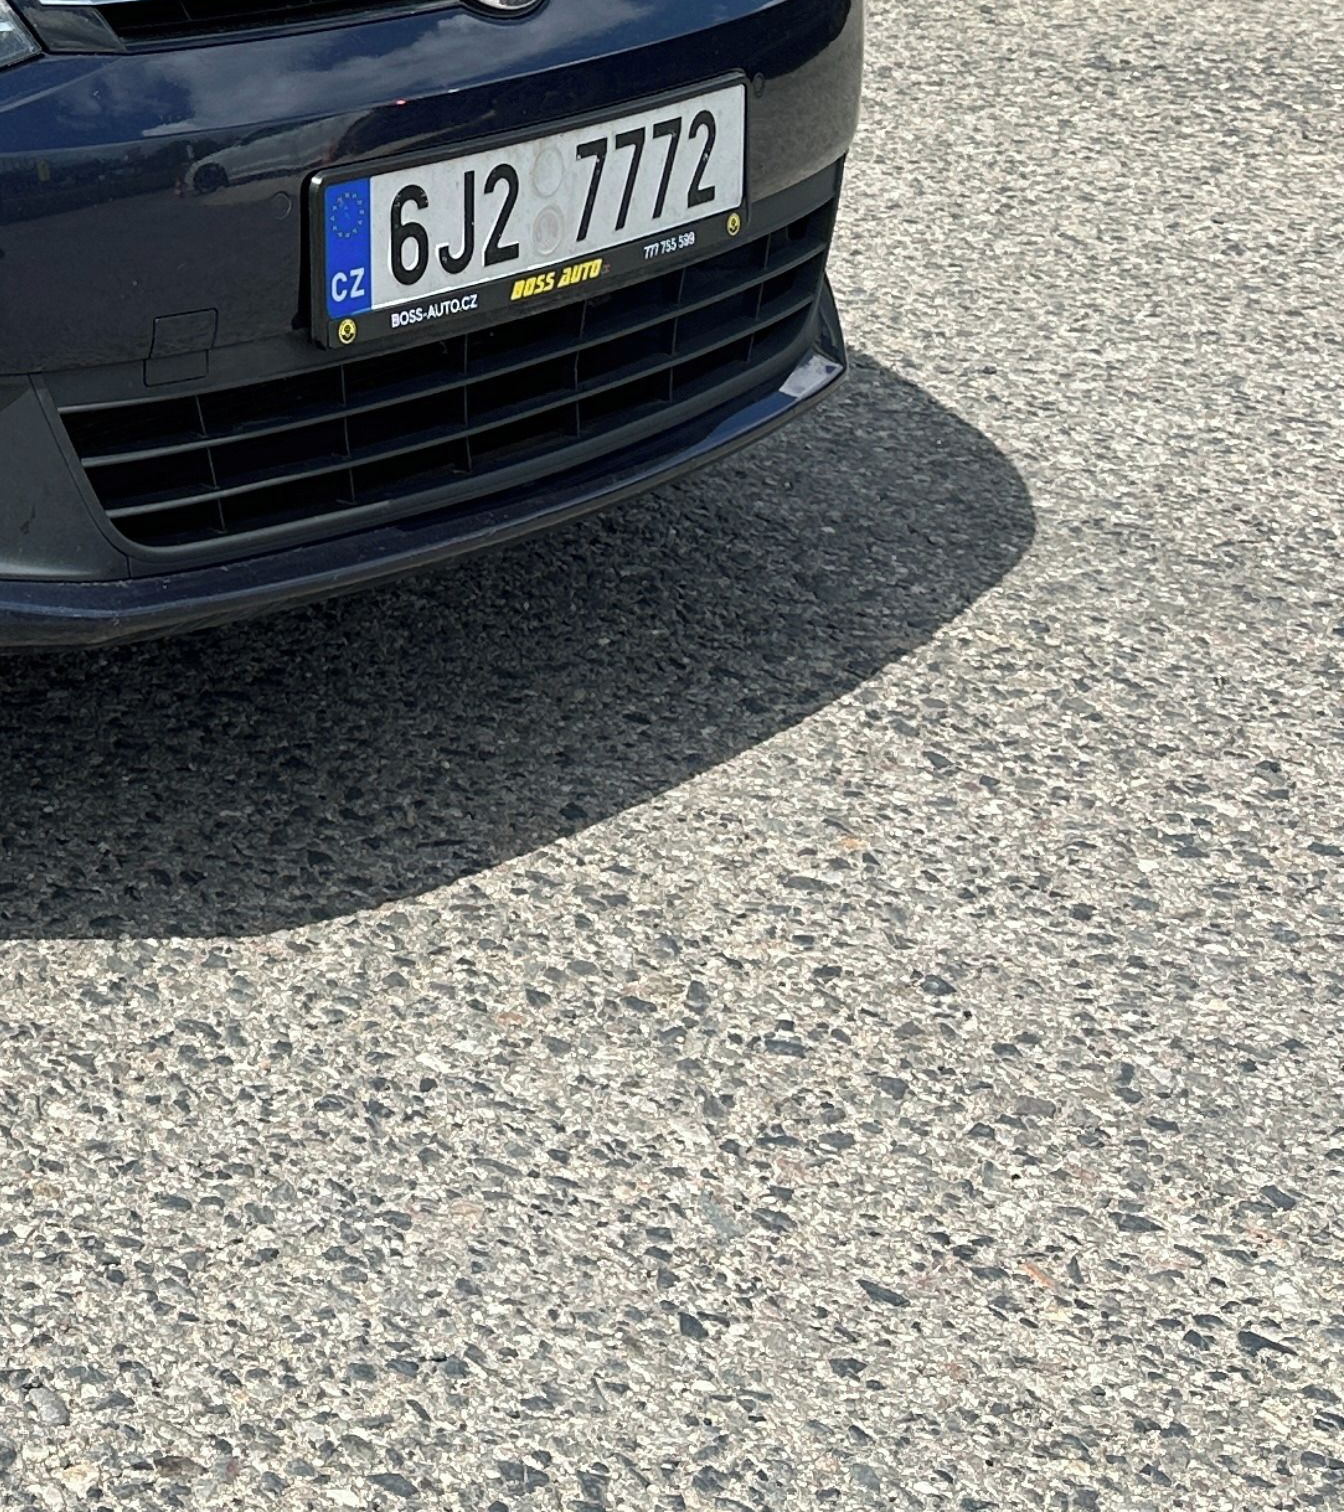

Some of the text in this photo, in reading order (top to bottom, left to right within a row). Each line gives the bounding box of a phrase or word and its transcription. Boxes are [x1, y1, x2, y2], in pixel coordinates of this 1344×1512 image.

[389, 109, 718, 287] 6J2 7772
[331, 267, 365, 302] CZ
[510, 258, 603, 301] BOSS AUTO
[391, 294, 478, 329] BOSS-AUTO.CZ
